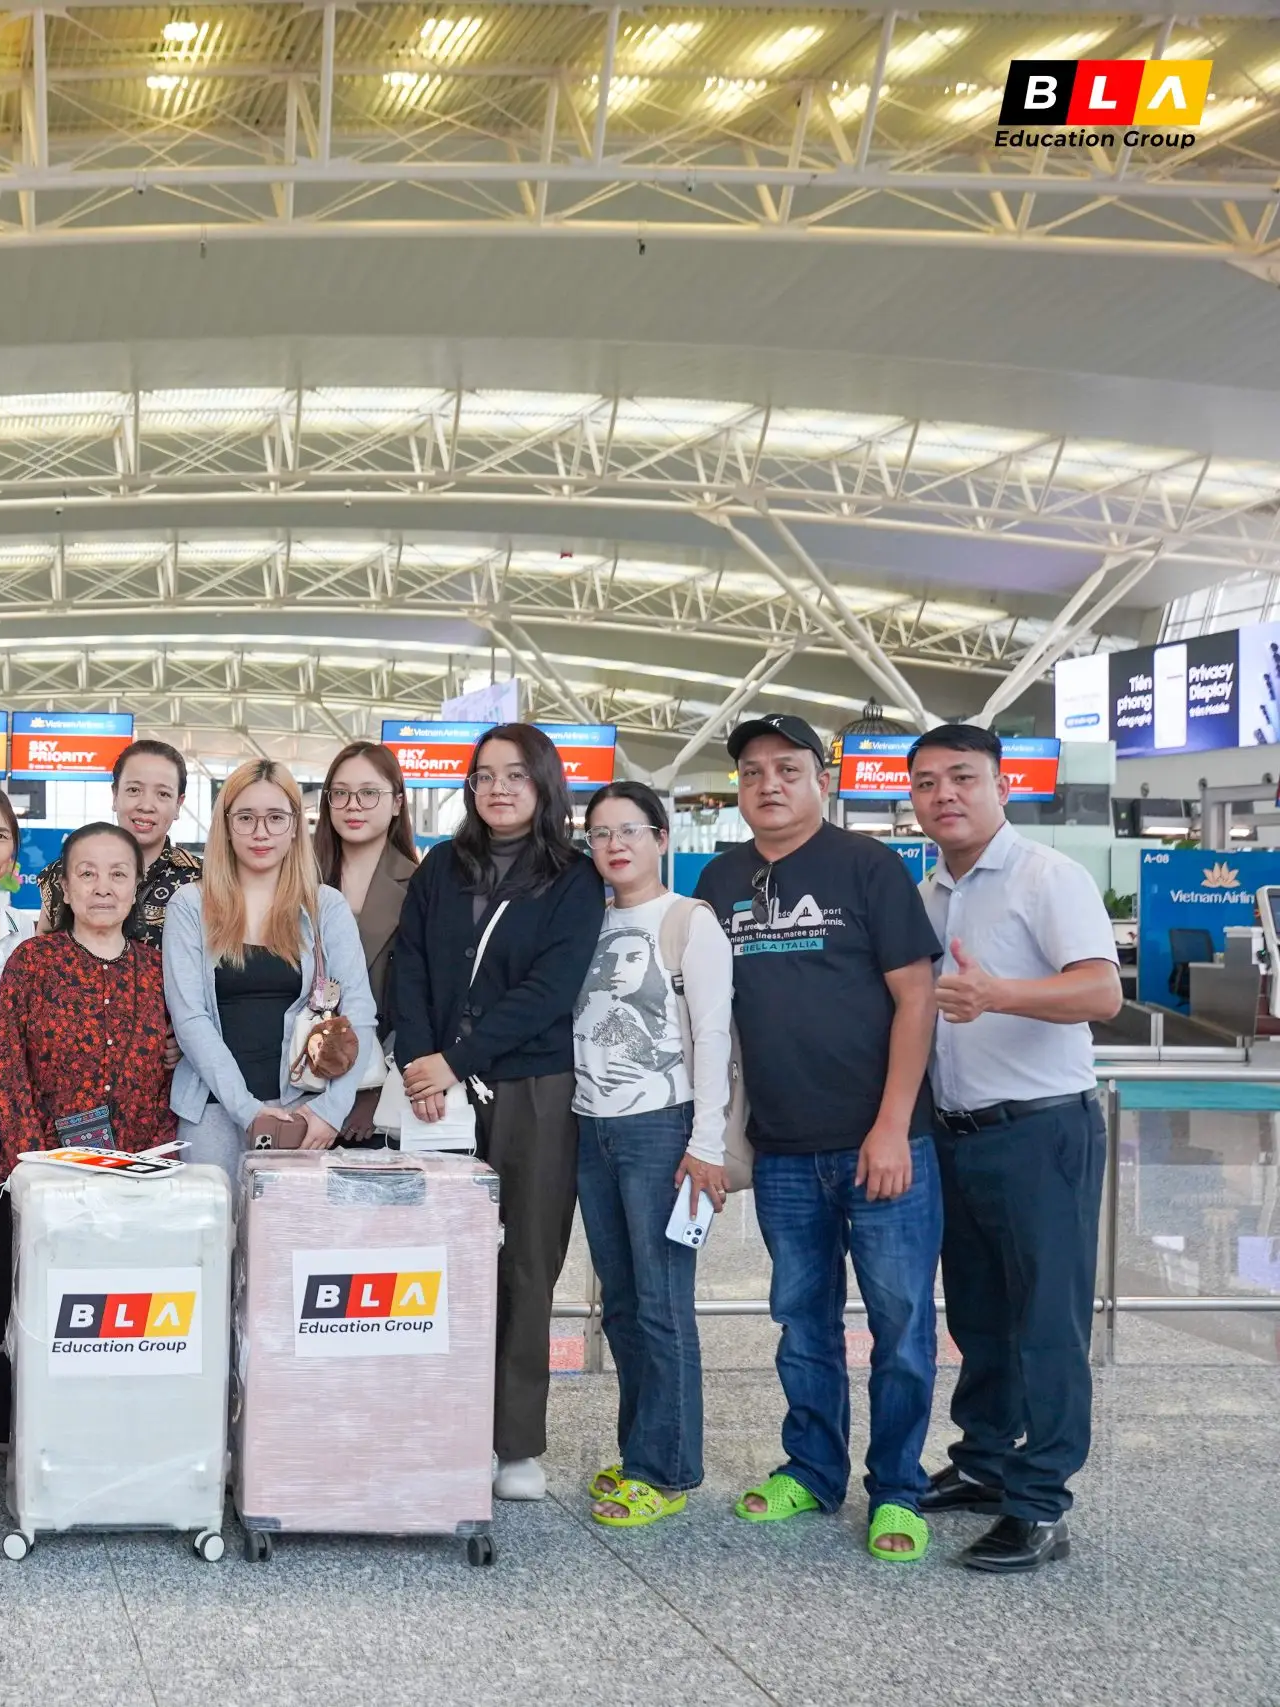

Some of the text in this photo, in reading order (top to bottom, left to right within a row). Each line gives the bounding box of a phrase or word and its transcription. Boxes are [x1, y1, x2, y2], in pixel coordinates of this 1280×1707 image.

[1188, 662, 1234, 683] Privacy
[1188, 681, 1233, 703] Display
[1117, 693, 1153, 715] phong
[28, 740, 59, 752] SKY
[28, 751, 95, 763] PRIORITY
[397, 748, 426, 760] SKY
[398, 759, 460, 770] PRIORITY
[856, 760, 884, 772] SKY
[897, 847, 921, 858] A-07
[1144, 853, 1170, 864] A-08
[1170, 889, 1255, 904] Vietnam Airlin
[731, 894, 824, 934] FLA
[781, 940, 819, 951] ITALIA
[315, 1282, 427, 1309] BLA
[69, 1301, 181, 1328] BLA
[298, 1319, 434, 1334] Education Group
[51, 1339, 187, 1353] Education Group
